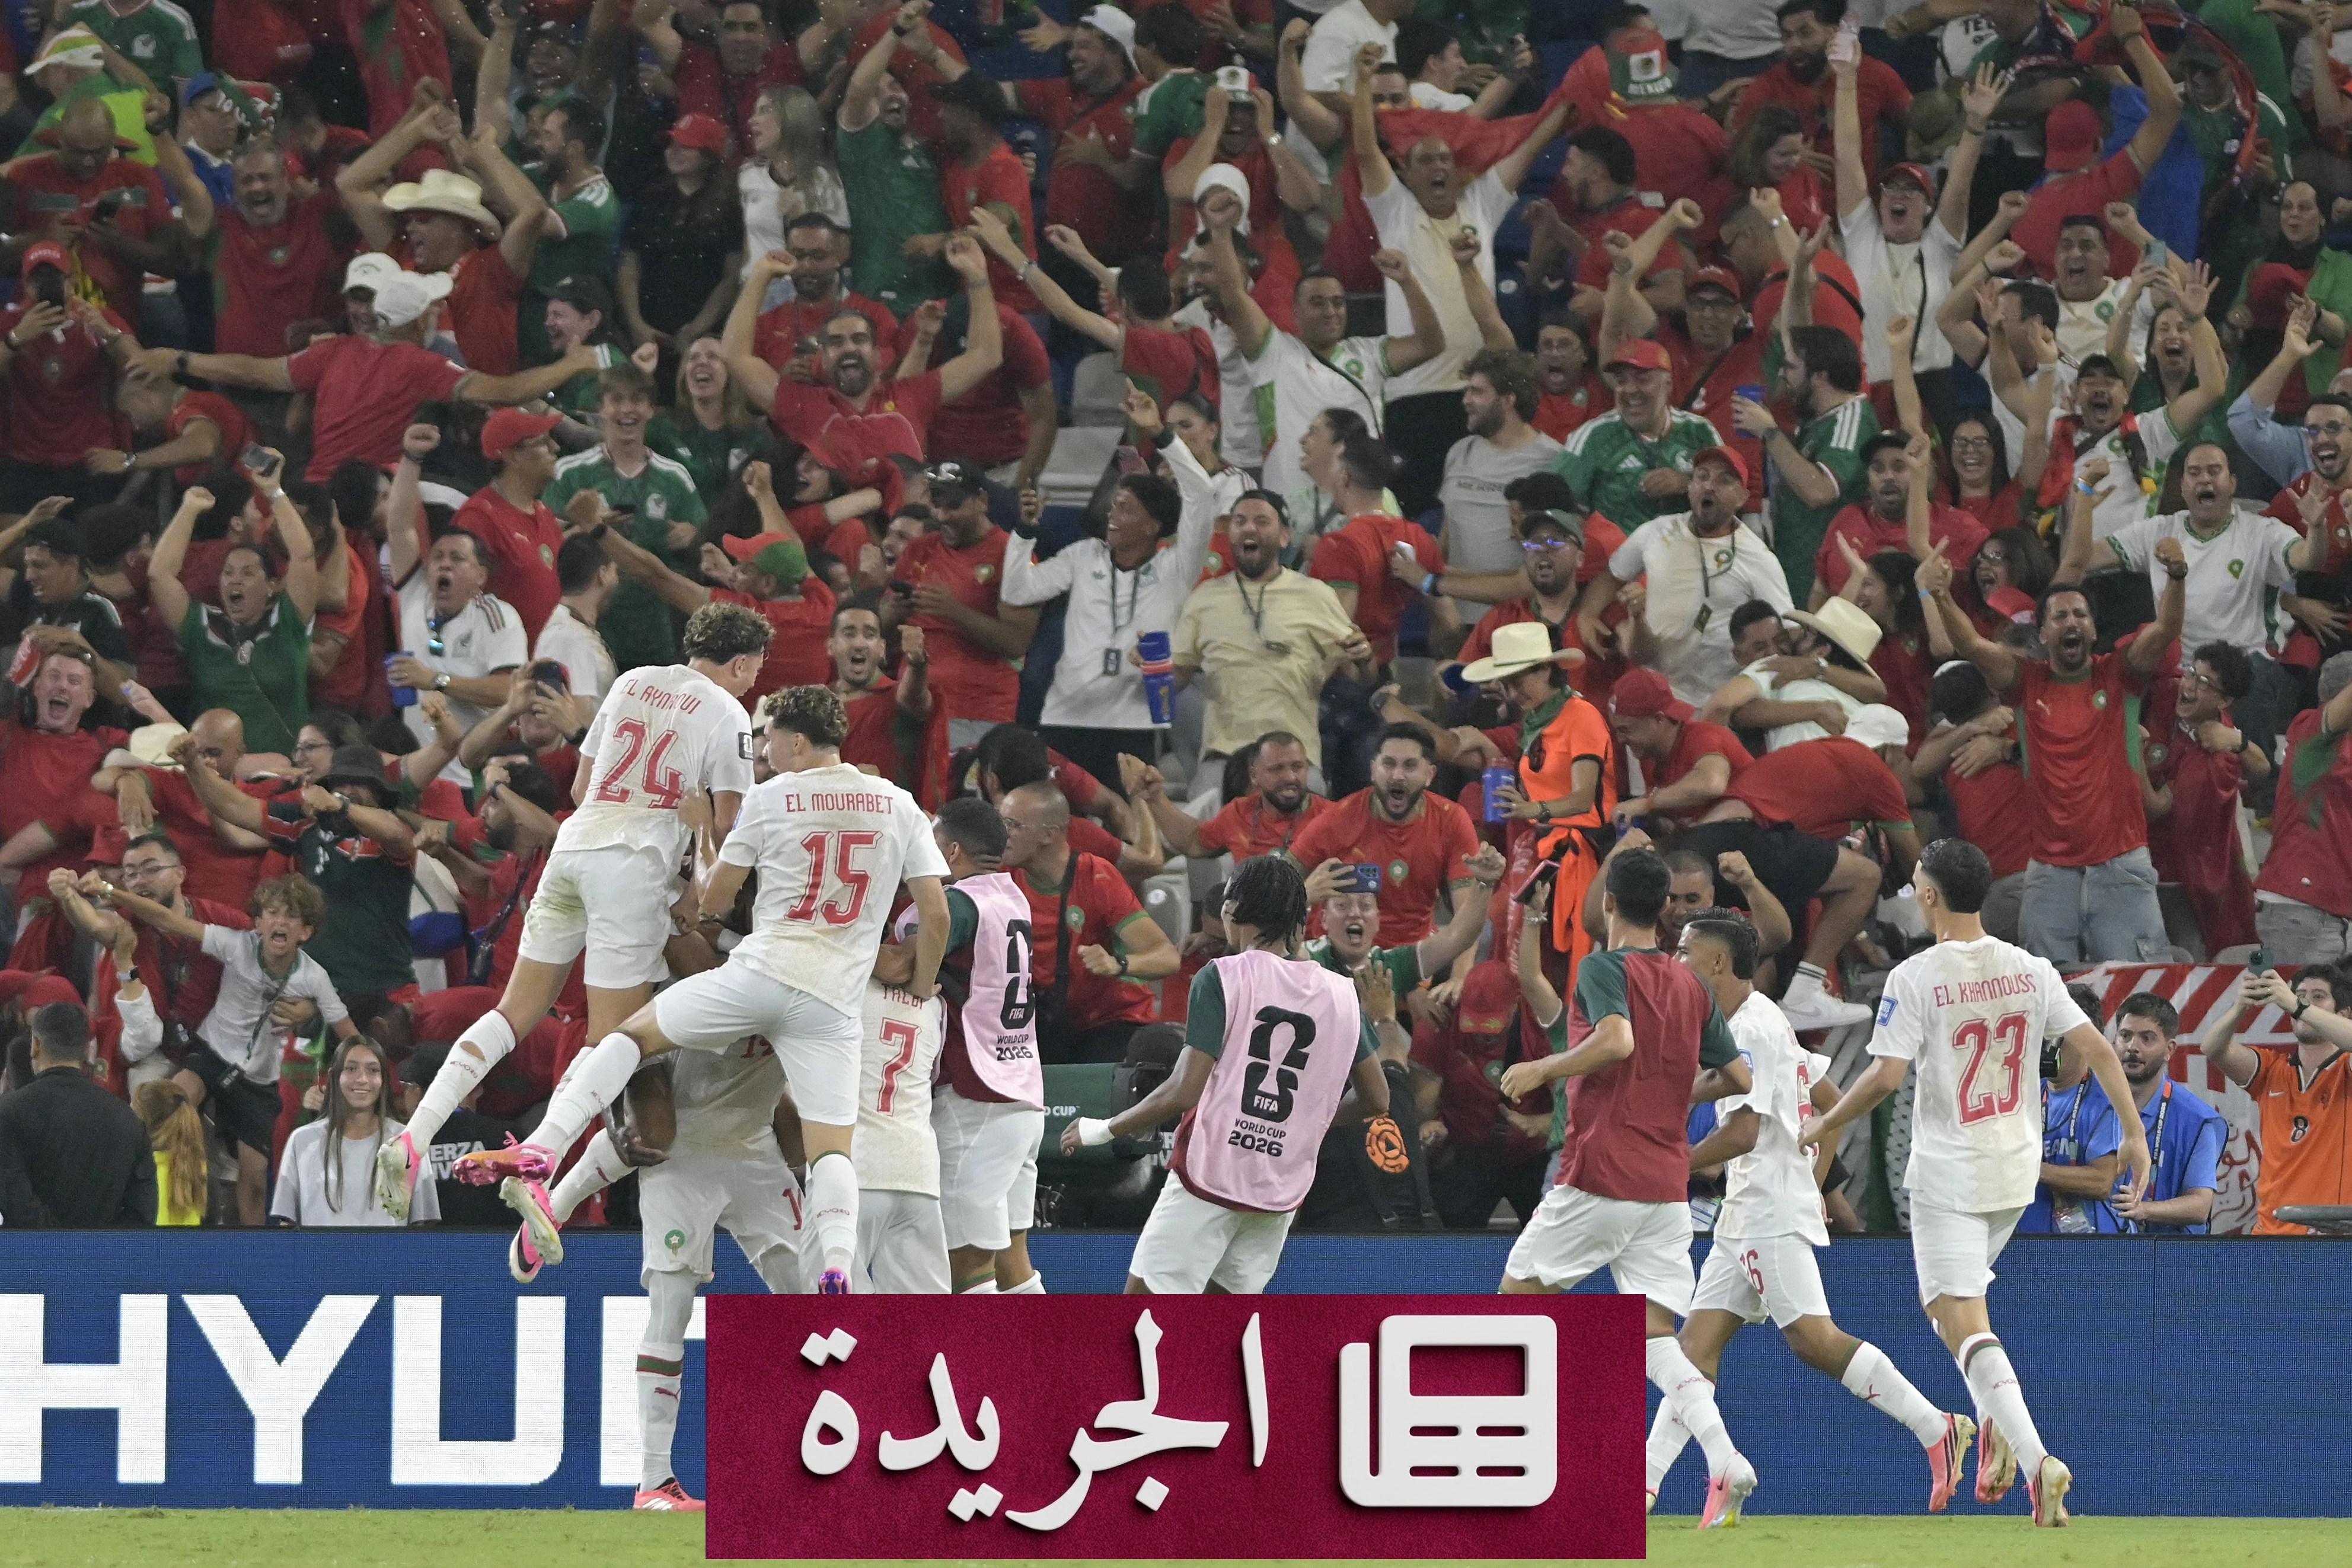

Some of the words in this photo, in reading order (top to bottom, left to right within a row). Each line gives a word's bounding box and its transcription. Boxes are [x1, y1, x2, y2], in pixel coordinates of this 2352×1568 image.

[620, 679, 639, 697] EL
[593, 716, 687, 810] 24
[785, 793, 806, 813] EL
[811, 792, 893, 815] MOURABET
[783, 829, 884, 930] 15
[1933, 984, 1955, 1008] EL
[1958, 973, 2037, 1003] KHANNOUSS
[1009, 1007, 1025, 1020] FIFA
[997, 1034, 1019, 1045] WORLD
[1019, 1033, 1029, 1043] CUP
[995, 1046, 1034, 1061] 2026
[876, 1016, 923, 1117] 7
[1952, 1010, 2030, 1128] 23
[1253, 1094, 1279, 1113] FIFA
[1266, 1126, 1287, 1139] CUP
[2290, 1115, 2309, 1145] 8
[1227, 1129, 1284, 1157] 2026
